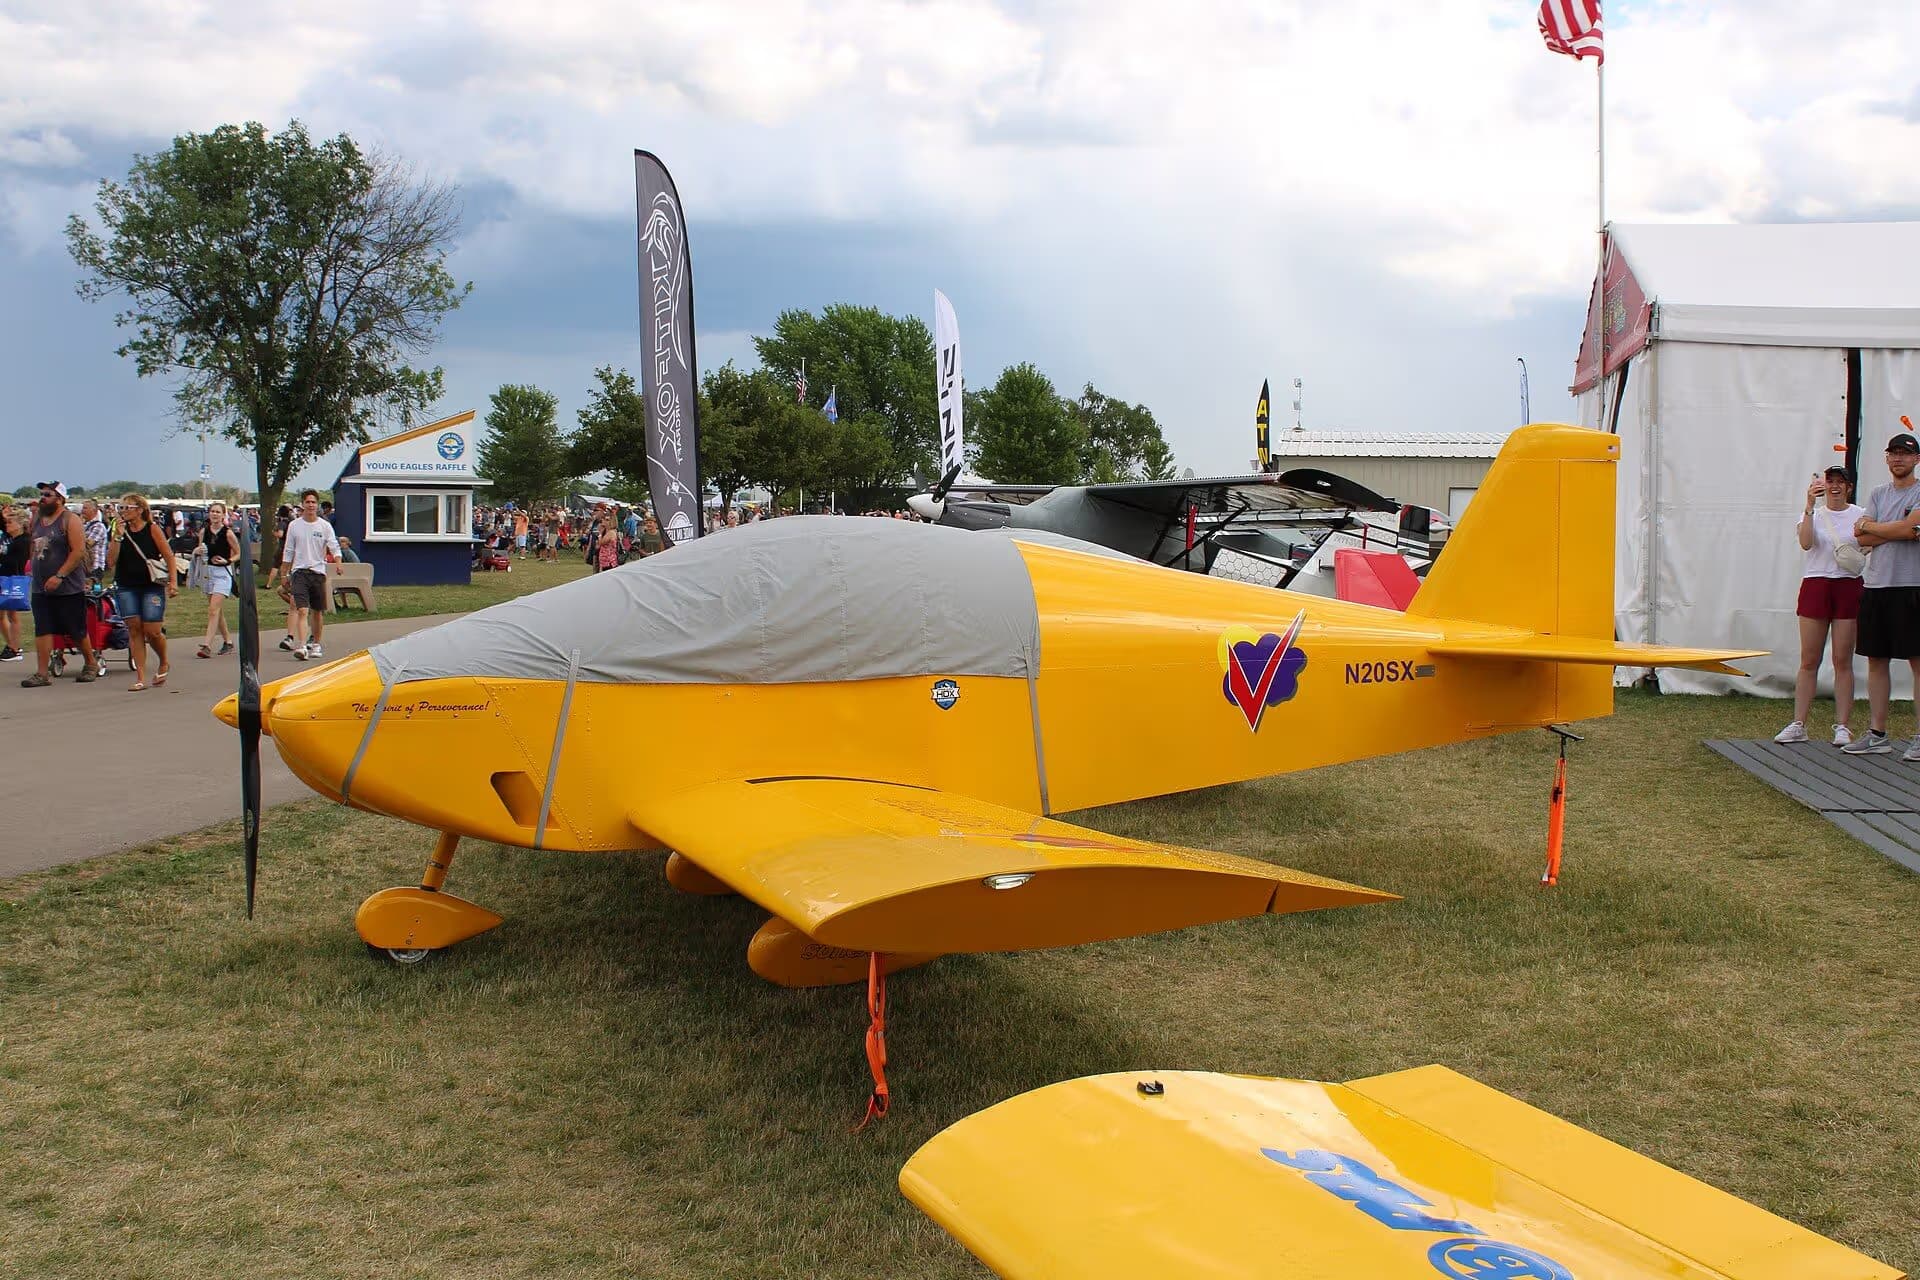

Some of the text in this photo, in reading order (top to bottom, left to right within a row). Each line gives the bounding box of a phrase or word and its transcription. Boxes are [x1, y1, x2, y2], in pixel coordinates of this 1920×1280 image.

[366, 462, 467, 471] YOUNG EAGLES RAFFLE
[1345, 660, 1415, 684] N20SX
[936, 690, 954, 698] HDX
[352, 703, 369, 712] The
[405, 703, 416, 713] of
[419, 701, 490, 712] Perseverance!
